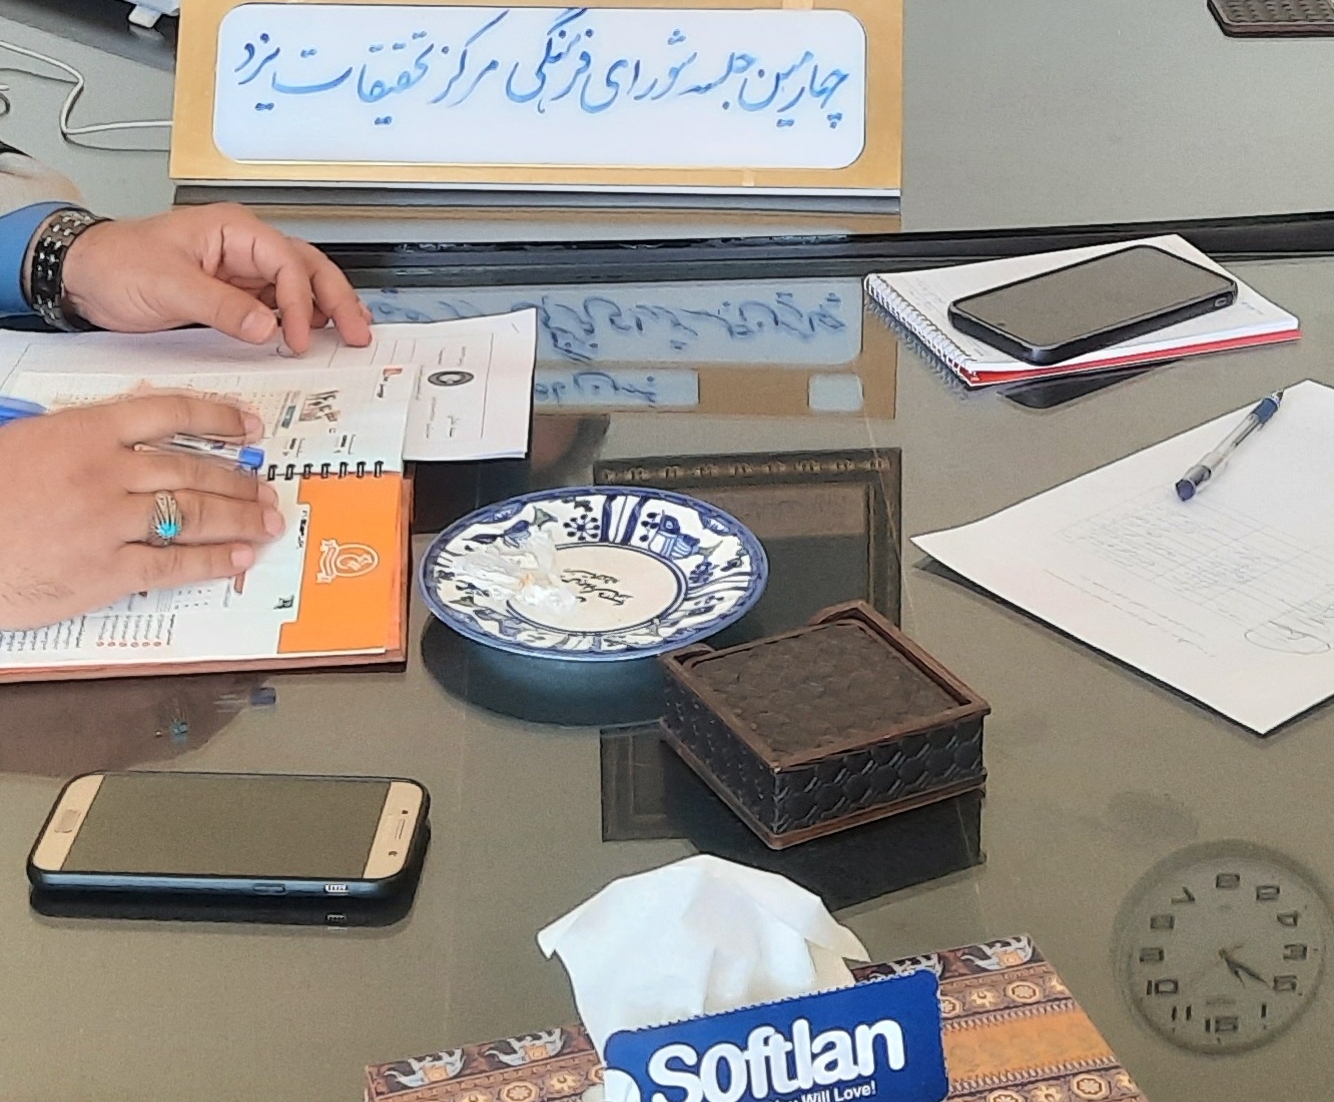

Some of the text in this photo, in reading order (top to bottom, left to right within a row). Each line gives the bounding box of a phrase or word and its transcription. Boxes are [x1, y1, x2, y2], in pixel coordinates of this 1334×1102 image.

[234, 7, 850, 128] چهارمین جلسه شورای فرهنگی مرکز تحقیقات یزد
[648, 1018, 905, 1102] Softlan
[833, 1080, 876, 1102] Love!
